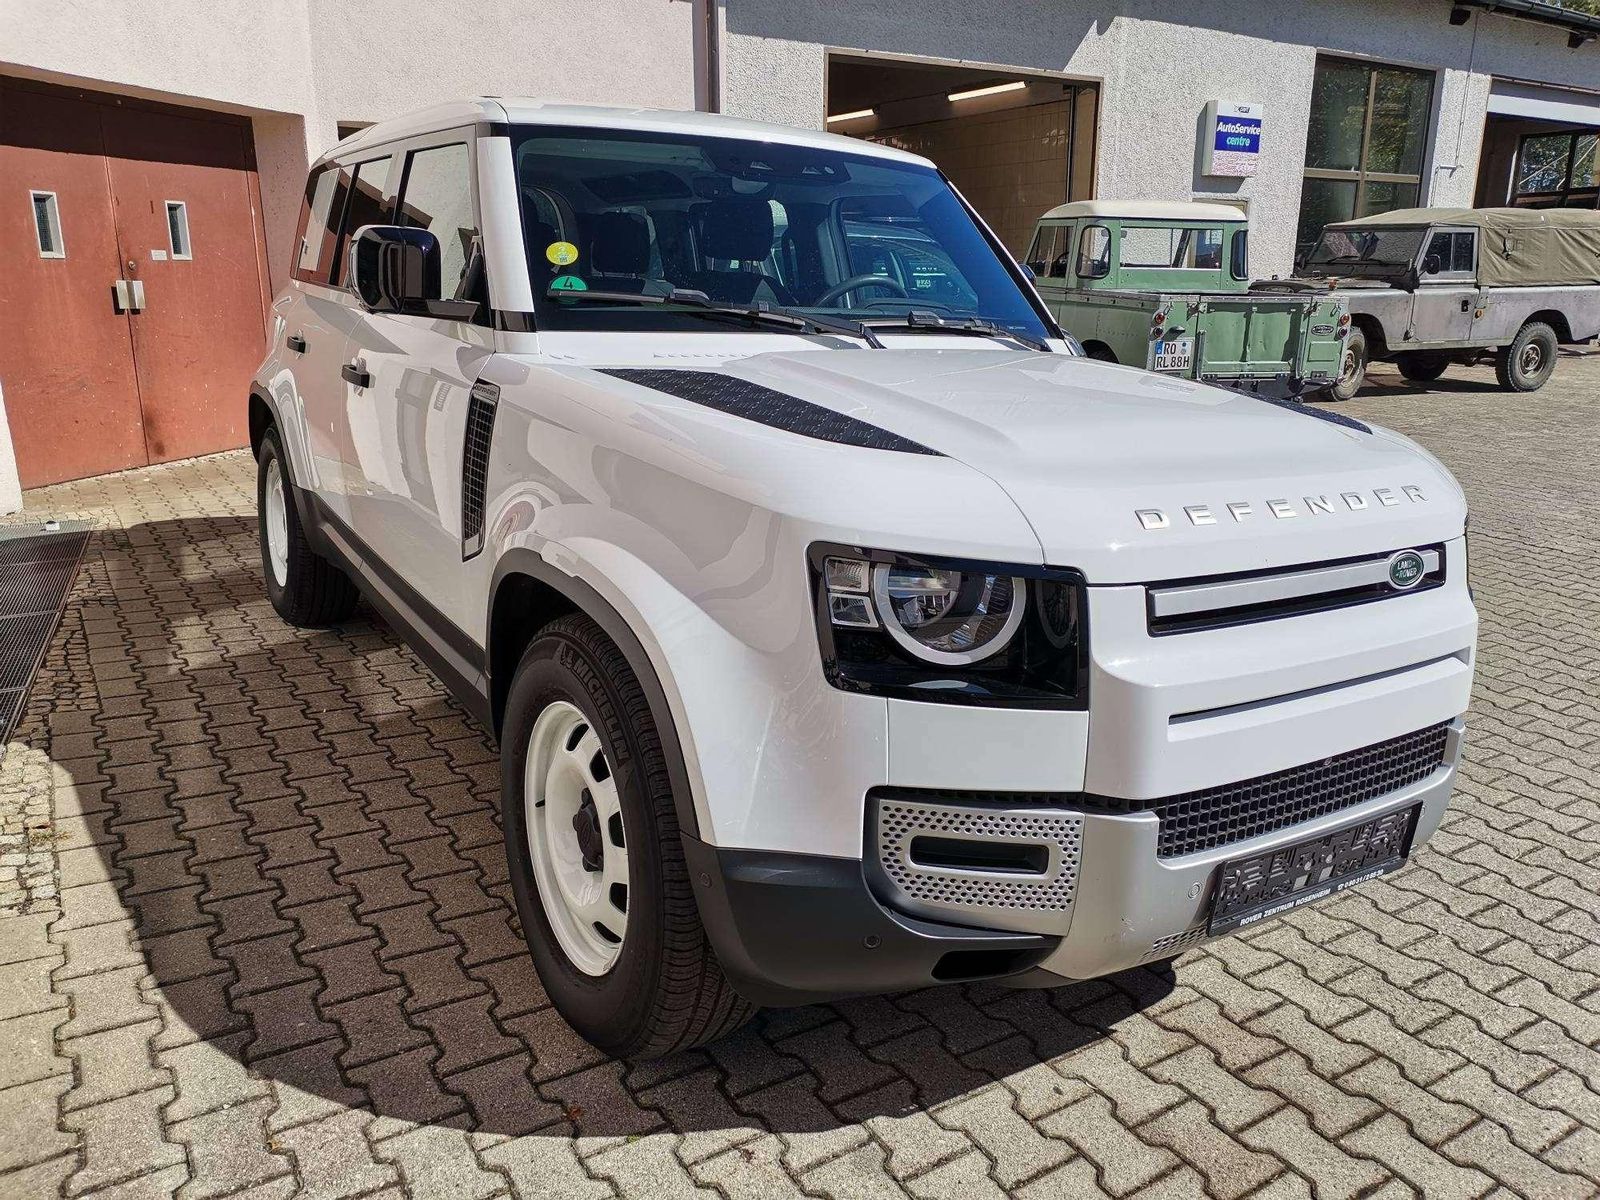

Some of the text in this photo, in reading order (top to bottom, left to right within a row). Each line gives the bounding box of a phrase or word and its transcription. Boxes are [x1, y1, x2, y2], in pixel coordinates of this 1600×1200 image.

[1216, 121, 1261, 135] AutoService
[1226, 136, 1251, 147] centre
[563, 277, 574, 289] 4
[1163, 343, 1177, 355] RO
[1134, 484, 1429, 531] DEFENDER
[1397, 559, 1413, 570] LAND
[1398, 567, 1418, 579] ROVER
[572, 657, 630, 763] MICHELIN
[1239, 913, 1263, 927] ROVER
[1263, 901, 1295, 917] ZENTRUM
[1295, 888, 1332, 907] ROSENHEIM
